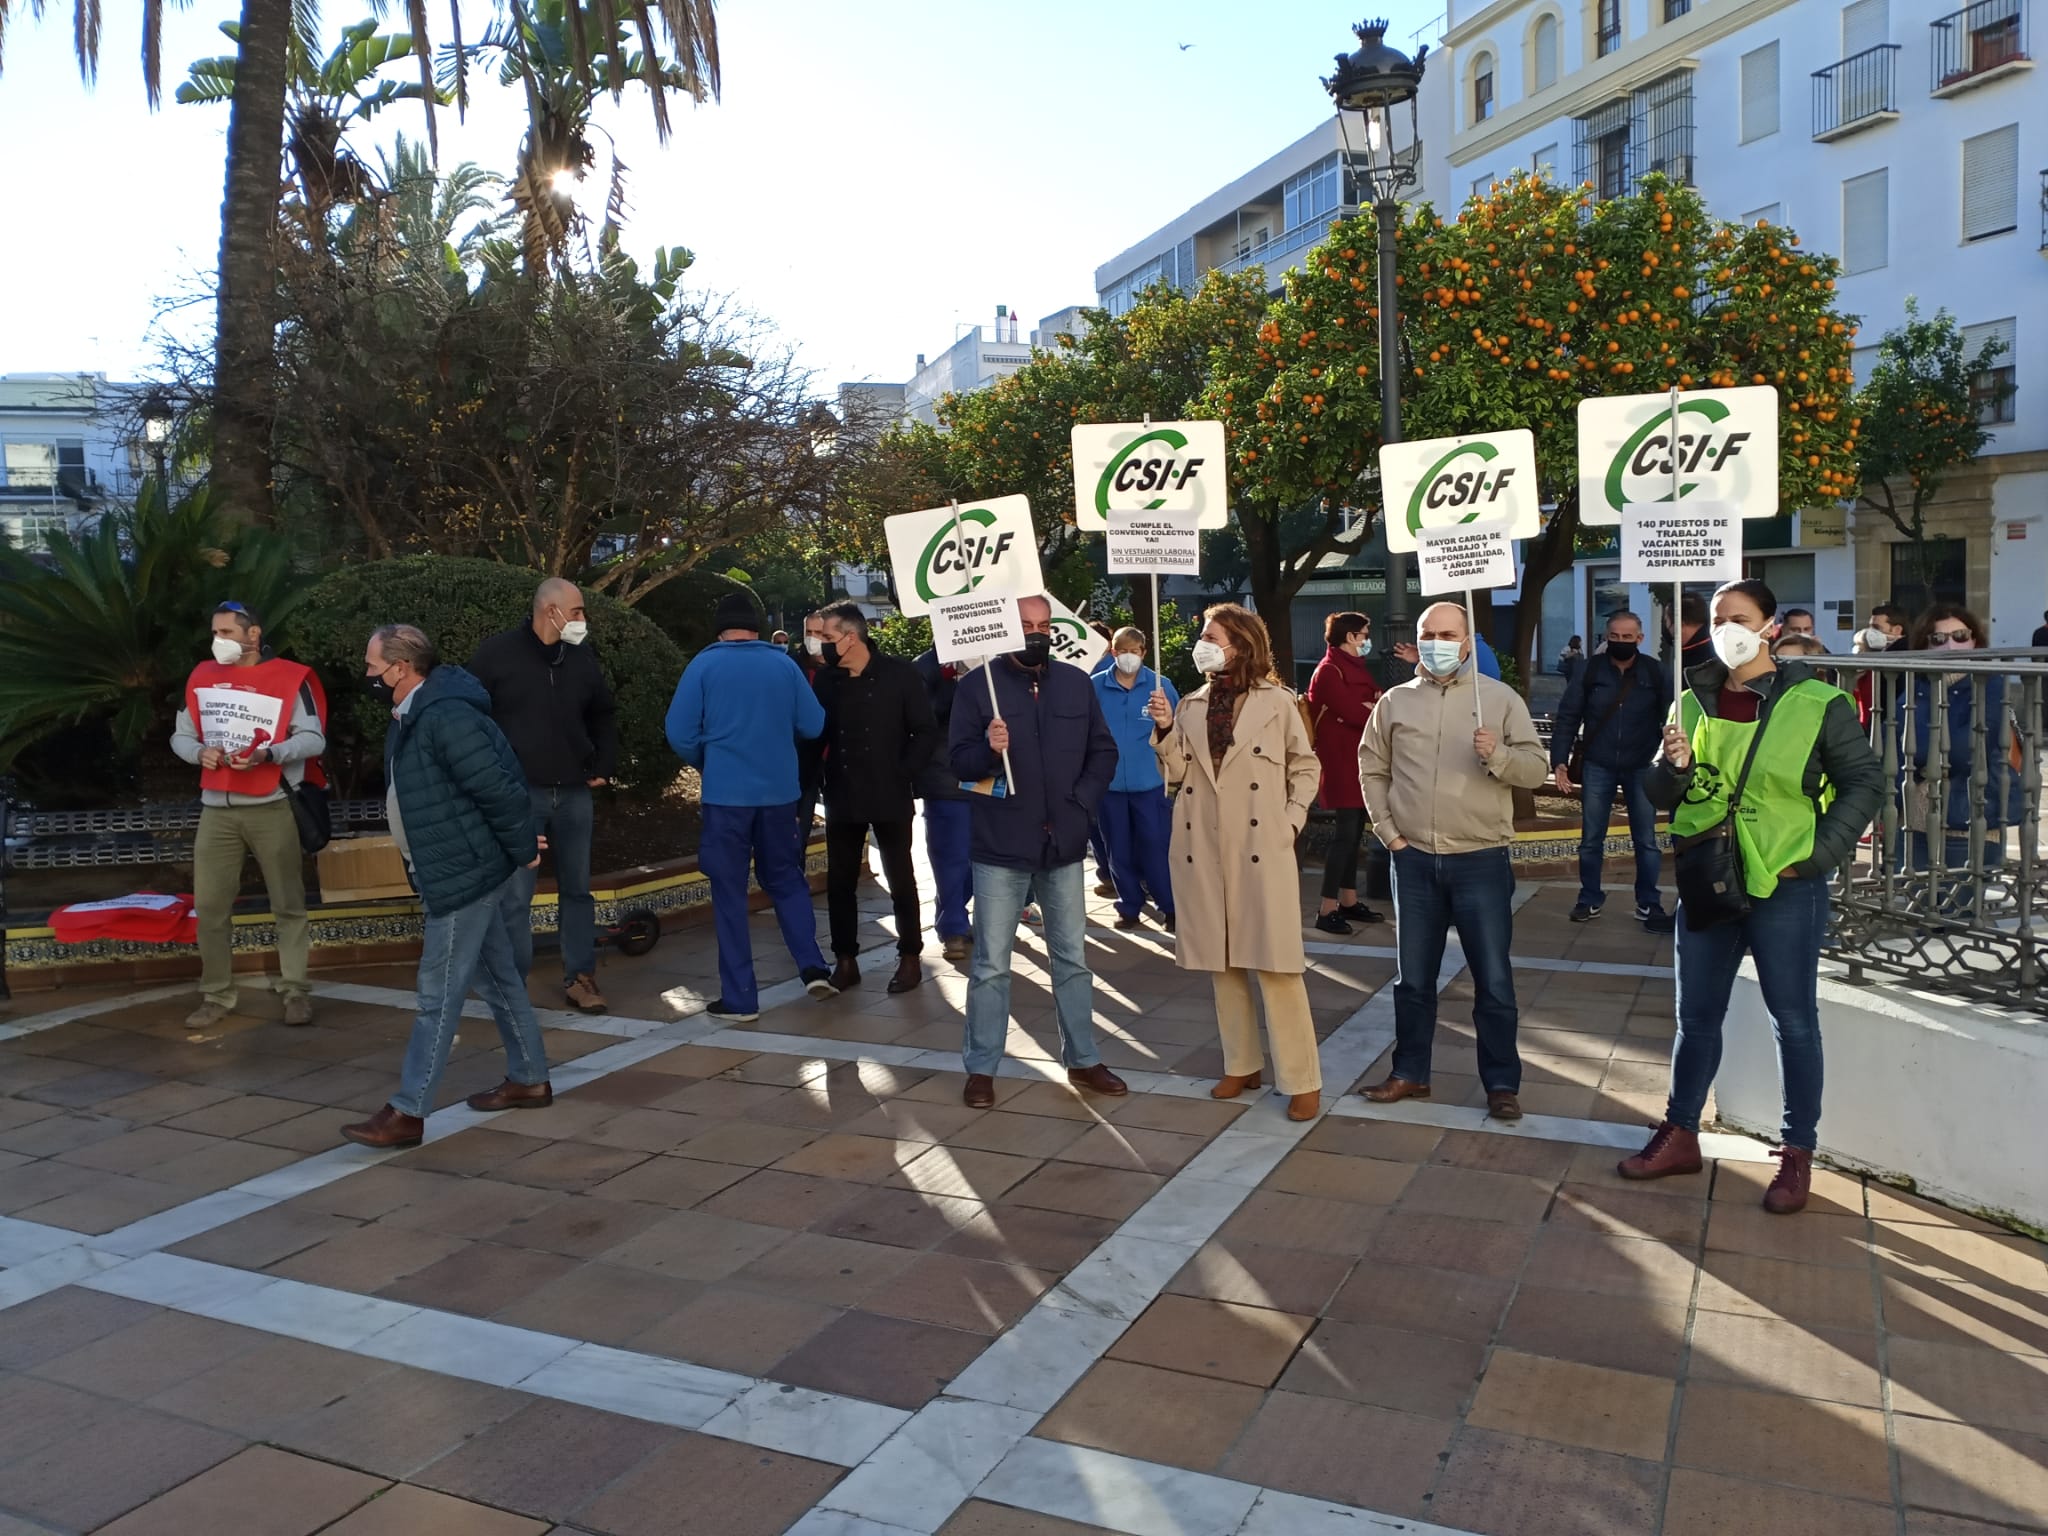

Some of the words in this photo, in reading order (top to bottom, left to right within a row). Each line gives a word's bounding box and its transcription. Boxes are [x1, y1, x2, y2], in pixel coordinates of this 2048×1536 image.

[1637, 520, 1656, 529] 140
[1658, 519, 1710, 528] PUESTOS
[1713, 519, 1728, 527] DE
[1656, 529, 1707, 538] TRABAJO
[1426, 538, 1456, 547] MAYOR
[1458, 534, 1488, 543] CARGA
[1489, 532, 1501, 540] DE
[1642, 539, 1700, 548] VACANTES
[1702, 539, 1722, 547] SIN
[1164, 548, 1196, 556] LABORAL
[1440, 543, 1480, 554] TRABAJO
[1638, 549, 1707, 558] POSIBILIDAD
[1710, 548, 1725, 557] DE
[1160, 557, 1195, 565] TRABAJAR
[1424, 548, 1506, 564] RESPONSABILIDAD,
[1449, 560, 1473, 569] AÑOS
[1475, 558, 1489, 566] SIN
[1646, 558, 1716, 567] ASPIRANTES
[1448, 567, 1485, 578] COBRAR!
[940, 599, 999, 615] PROMOCIONES
[948, 606, 1003, 621] PROVISIONES
[953, 629, 959, 637] 2
[961, 625, 986, 636] AÑOS
[988, 622, 1004, 631] SIN
[951, 630, 1009, 646] SOLUCIONES
[206, 702, 236, 710] CUMPLE
[238, 704, 249, 712] EL
[222, 710, 273, 726] COLECTIVO
